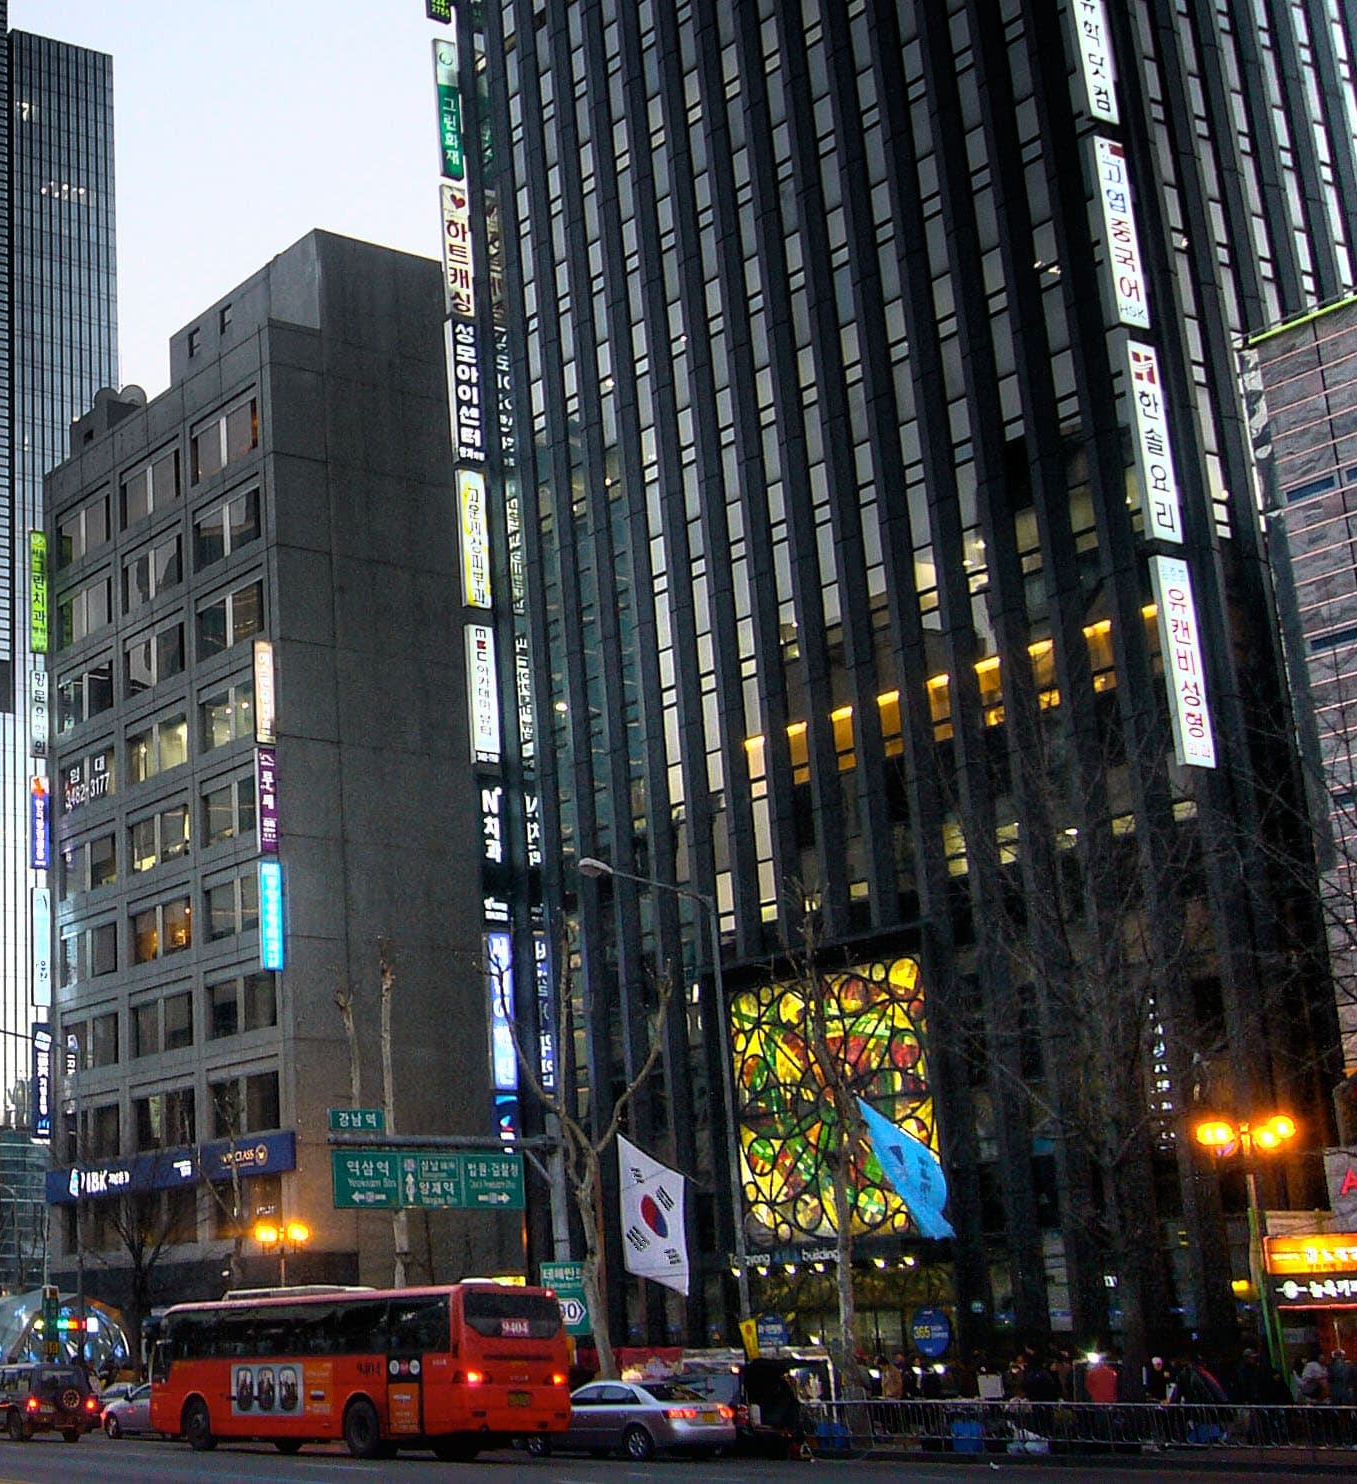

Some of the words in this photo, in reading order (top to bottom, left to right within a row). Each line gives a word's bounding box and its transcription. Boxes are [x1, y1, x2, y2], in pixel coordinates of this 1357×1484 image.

[443, 97, 460, 165] 그린화재
[446, 219, 472, 313] 하트캐싱
[455, 323, 483, 448] 성모아이센터
[1137, 388, 1175, 534] 한솔요리
[338, 1112, 377, 1128] 강남역
[347, 1160, 390, 1177] 역삼역
[419, 1182, 455, 1196] 양재역
[501, 1320, 530, 1334] 9404
